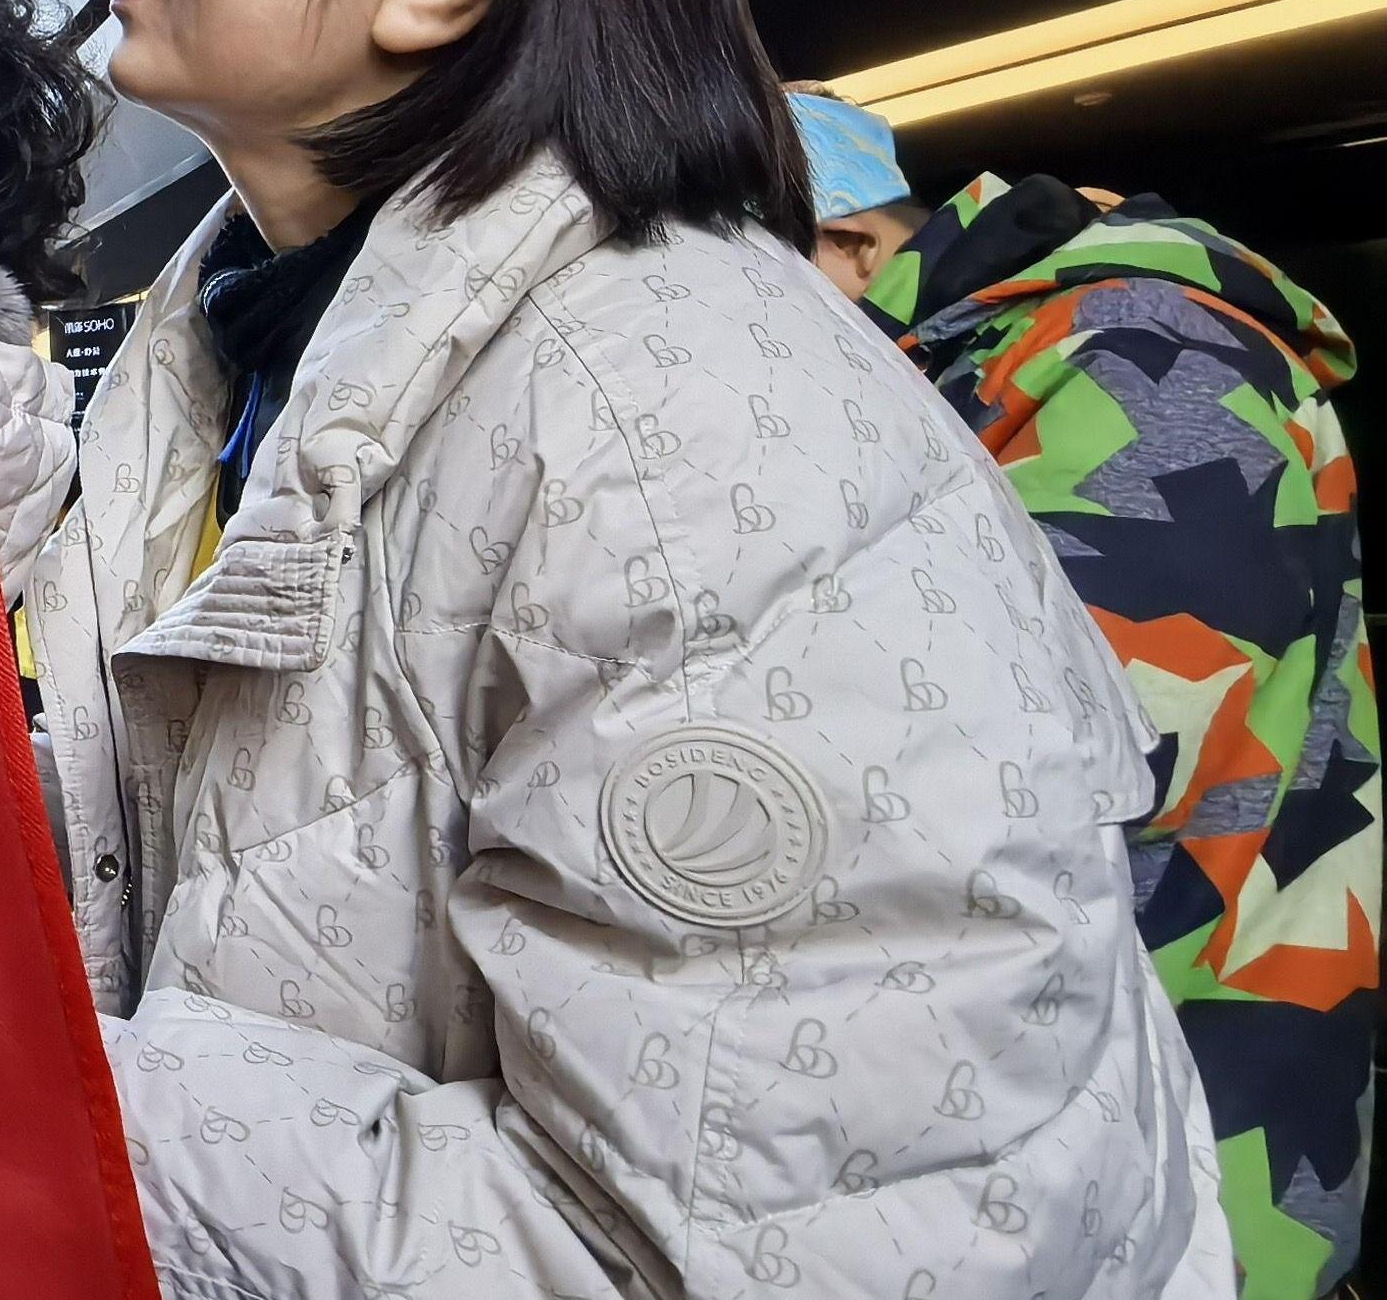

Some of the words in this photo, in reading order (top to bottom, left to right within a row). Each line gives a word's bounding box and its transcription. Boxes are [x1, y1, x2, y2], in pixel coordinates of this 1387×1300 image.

[635, 748, 768, 788] BOSIDENG
[661, 874, 733, 908] SINCE
[742, 870, 788, 904] 1976
